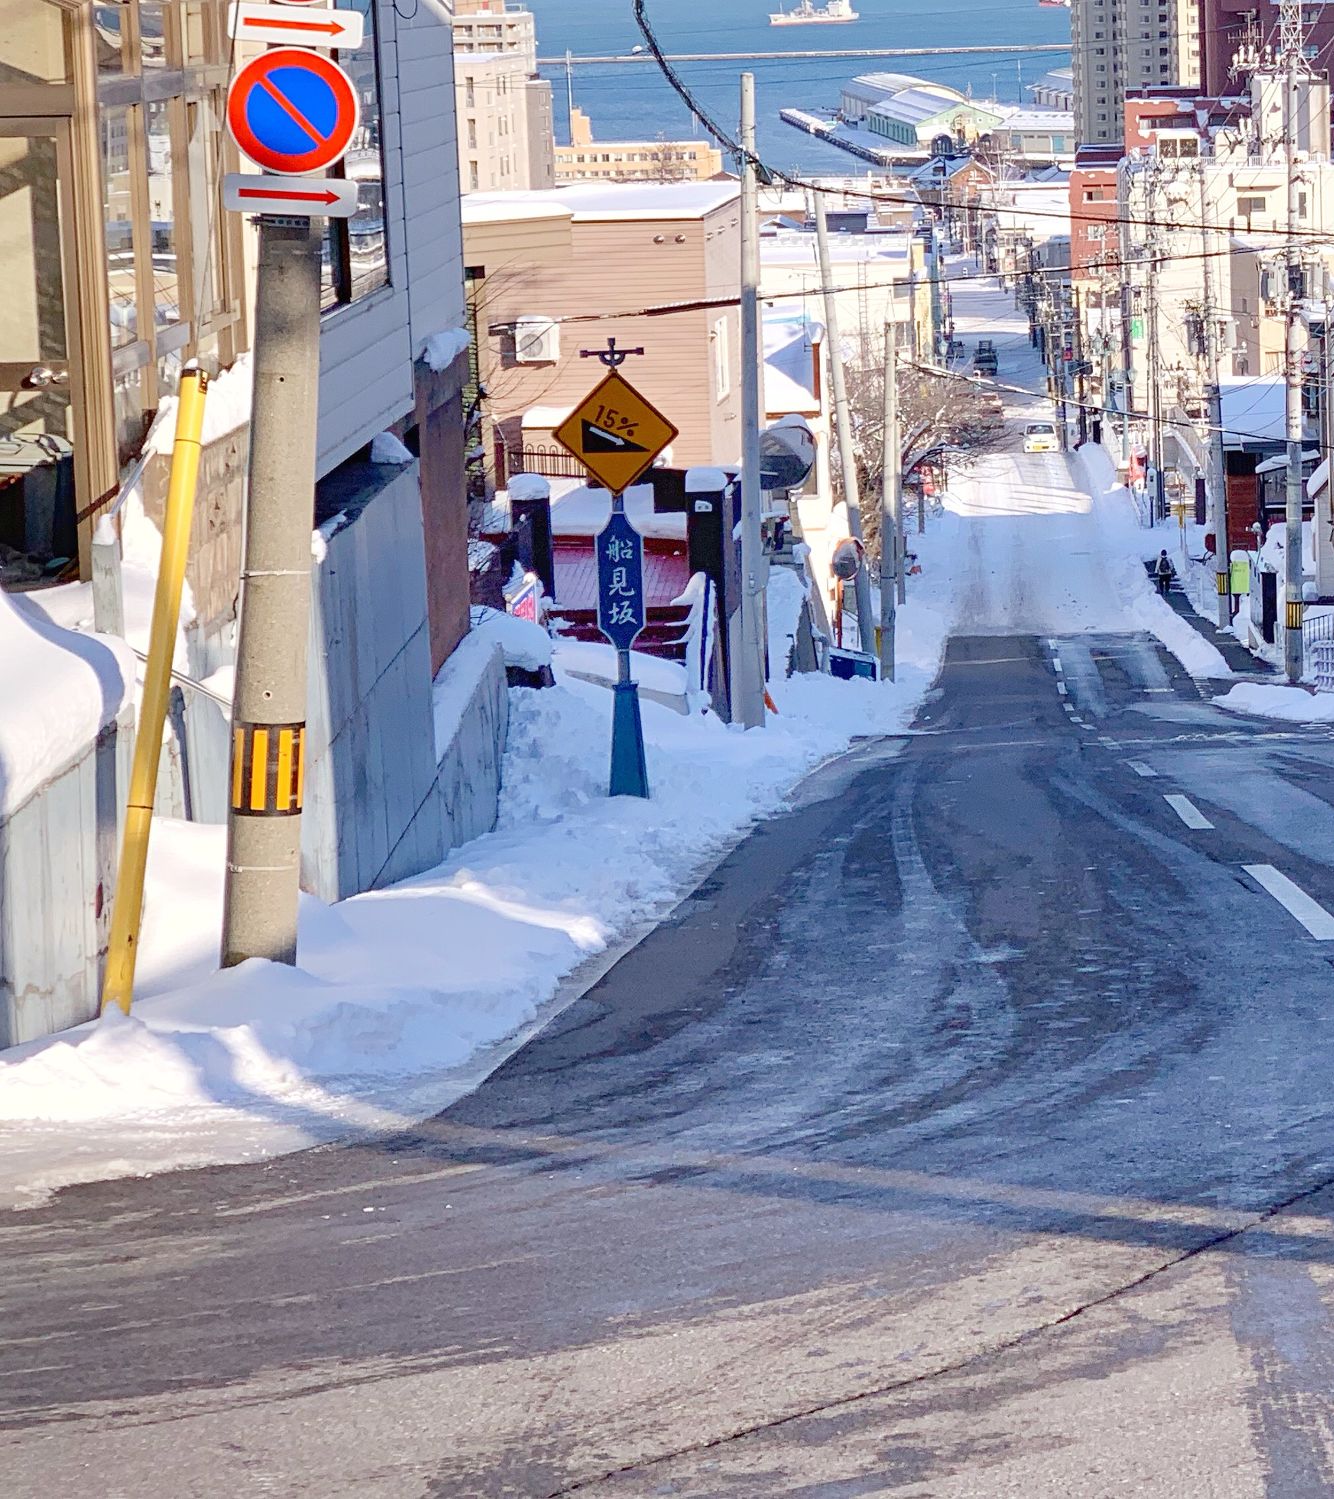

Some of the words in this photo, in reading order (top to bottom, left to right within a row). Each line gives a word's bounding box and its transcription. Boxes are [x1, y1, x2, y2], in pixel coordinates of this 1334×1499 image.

[594, 404, 640, 437] 15%
[605, 534, 638, 625] 船見坂
